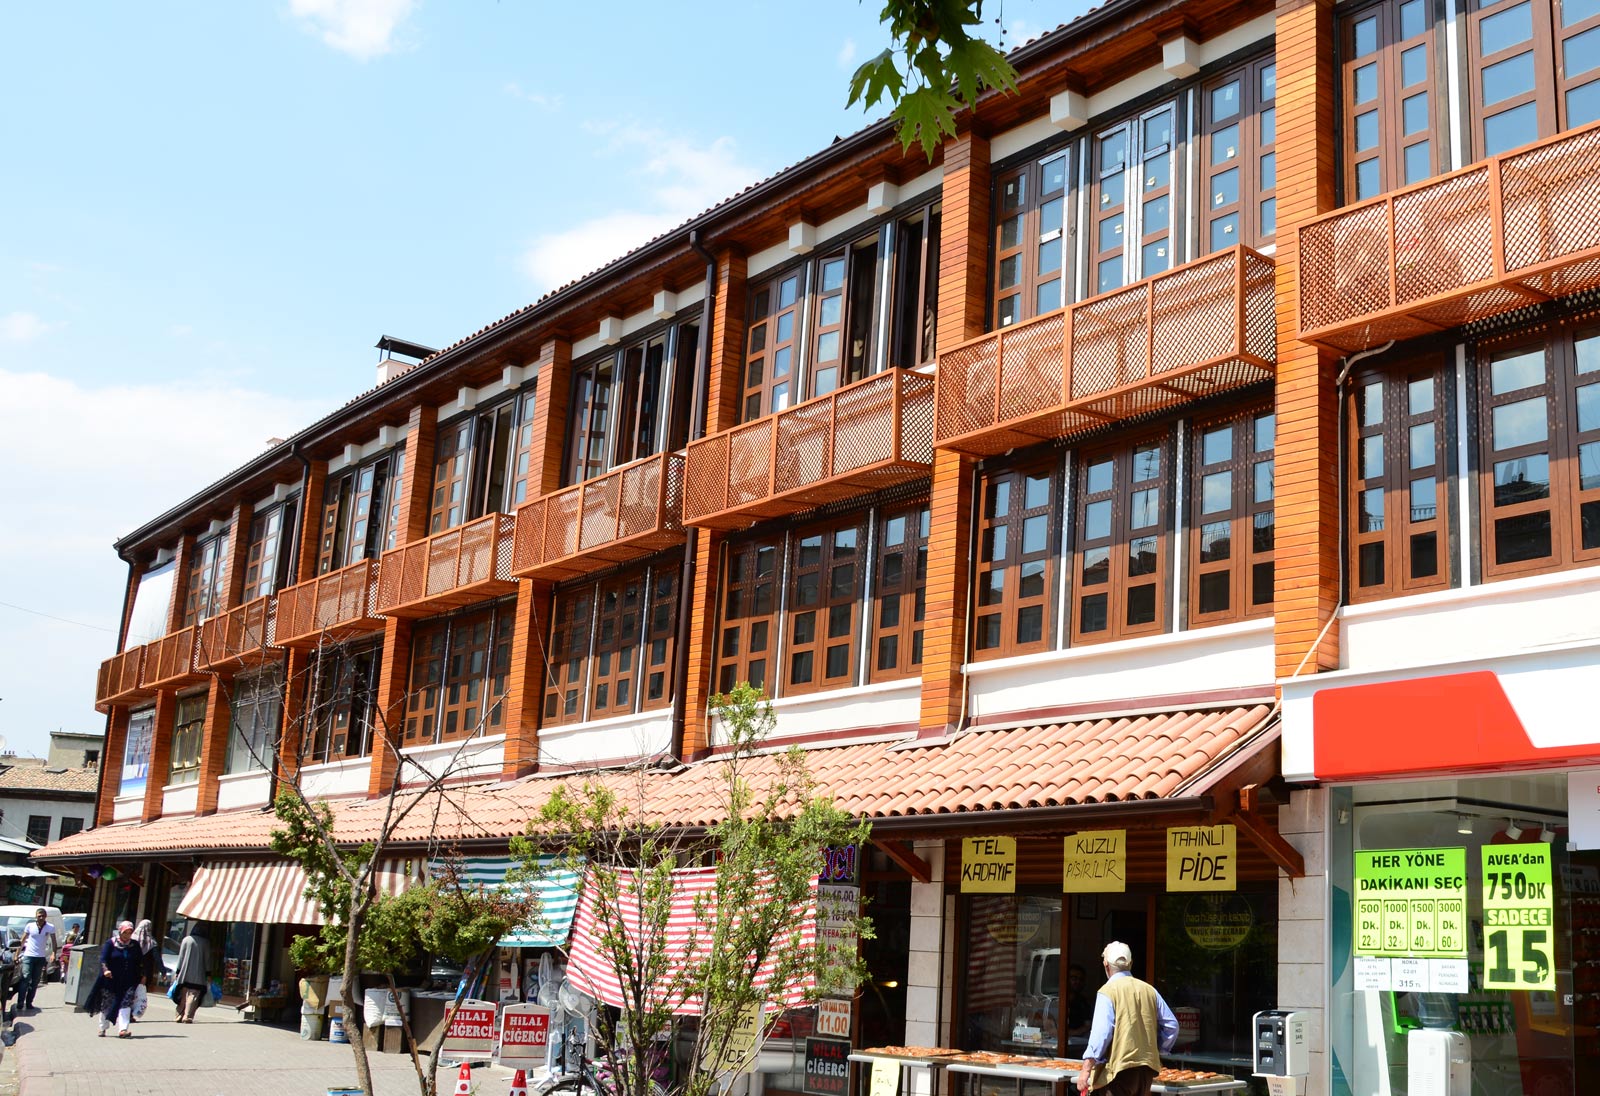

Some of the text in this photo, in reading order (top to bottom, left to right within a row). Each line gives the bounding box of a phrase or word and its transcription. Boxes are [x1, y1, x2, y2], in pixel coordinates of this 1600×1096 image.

[1171, 826, 1225, 847] TAHİNLİ
[972, 840, 1006, 855] TEL
[1076, 837, 1118, 854] KUZU
[1372, 851, 1445, 868] HER YÖNE
[1487, 853, 1545, 866] AVEA'dan
[1179, 852, 1228, 882] PİDE
[1360, 875, 1463, 893] DAKİKANI SEÇ
[1360, 904, 1380, 913] 500
[1385, 903, 1407, 912] 1000
[1412, 903, 1434, 912] 1500
[1438, 902, 1461, 912] 3000
[1487, 908, 1548, 925] SADECE
[1362, 920, 1379, 930] Dk.
[1389, 920, 1405, 930] Dk.
[1416, 920, 1431, 930] Dk.
[1442, 920, 1458, 930] Dk.
[1362, 935, 1371, 946] 22
[1388, 935, 1398, 947] 32
[1414, 936, 1424, 947] 40
[1441, 936, 1452, 948] 60
[1398, 980, 1414, 988] 315
[447, 1022, 493, 1037] CİĞERCİ
[819, 1014, 848, 1034] 11.00
[503, 1028, 547, 1043] CİĞERCİ
[812, 1041, 844, 1059] HİLAL
[806, 1058, 849, 1078] CİĞERCİ
[808, 1076, 844, 1091] KASAP
